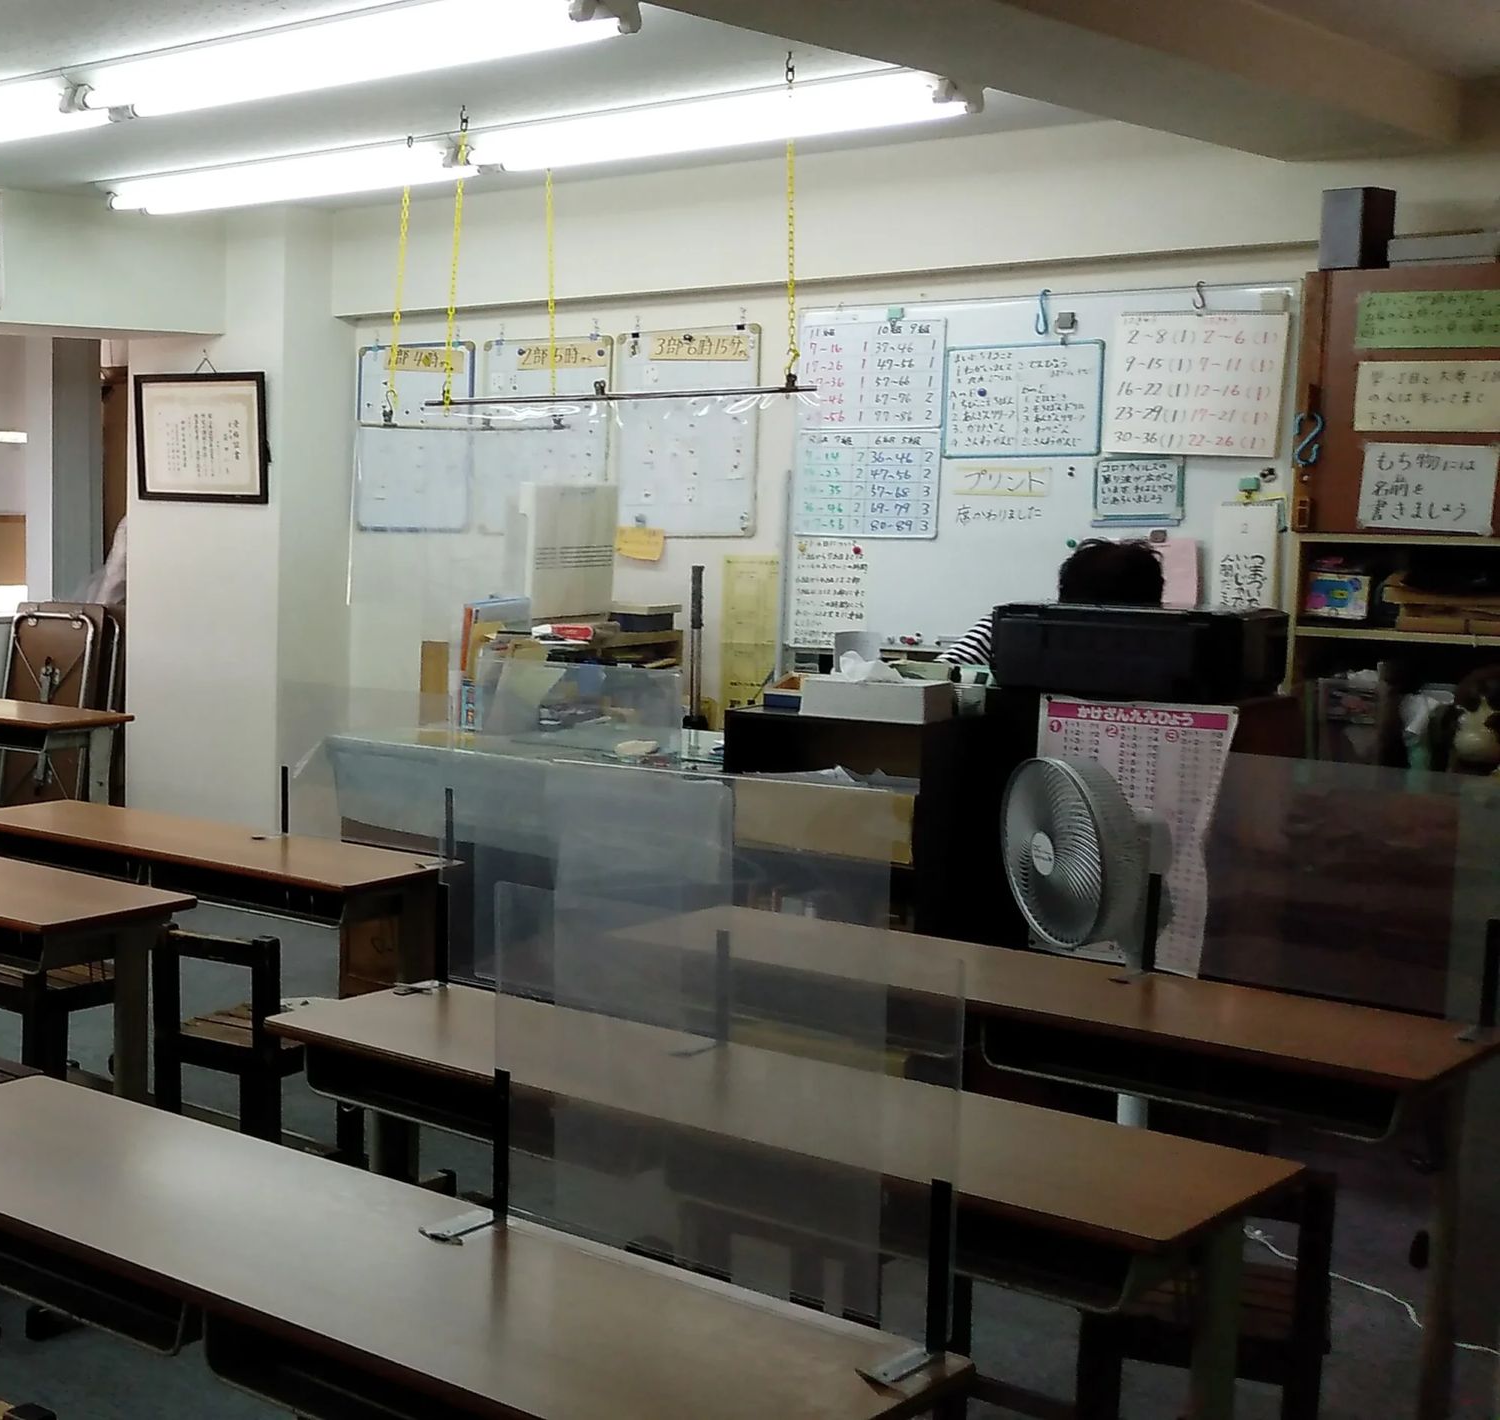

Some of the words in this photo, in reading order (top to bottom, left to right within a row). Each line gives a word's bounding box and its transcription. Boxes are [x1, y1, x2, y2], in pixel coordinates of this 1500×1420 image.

[1376, 451, 1476, 472] もち物には
[964, 468, 1045, 493] プリント
[1371, 474, 1424, 497] 名前を
[1371, 499, 1467, 521] 書きましょう
